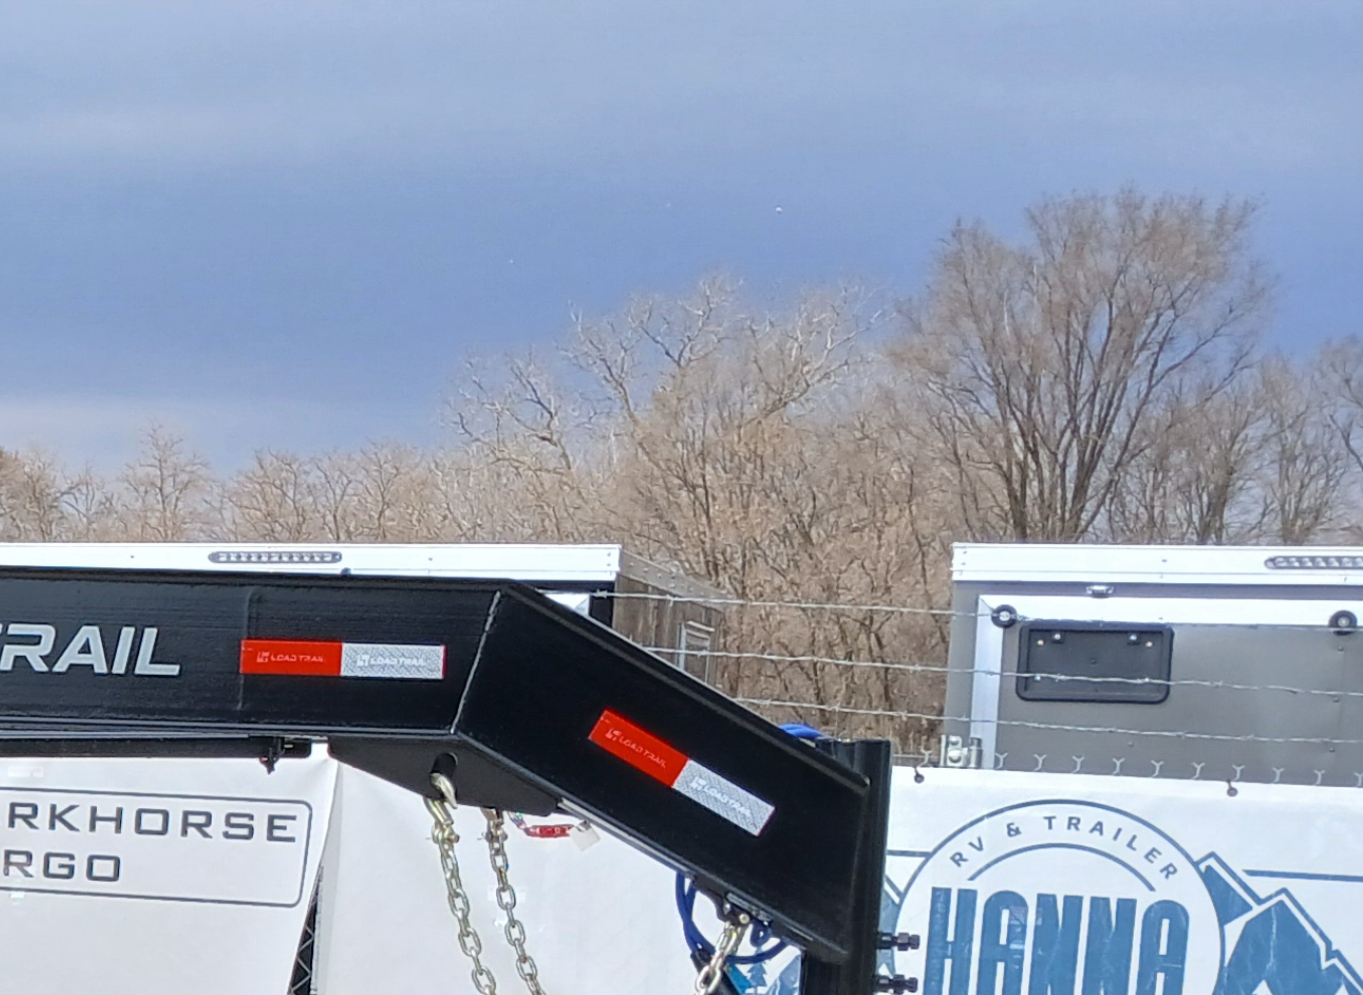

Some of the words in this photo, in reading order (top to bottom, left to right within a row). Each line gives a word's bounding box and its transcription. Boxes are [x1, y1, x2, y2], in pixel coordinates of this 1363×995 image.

[270, 654, 297, 662] LOAD
[949, 837, 985, 868] RV
[1005, 822, 1022, 838] &
[1043, 815, 1178, 880] TRAILER
